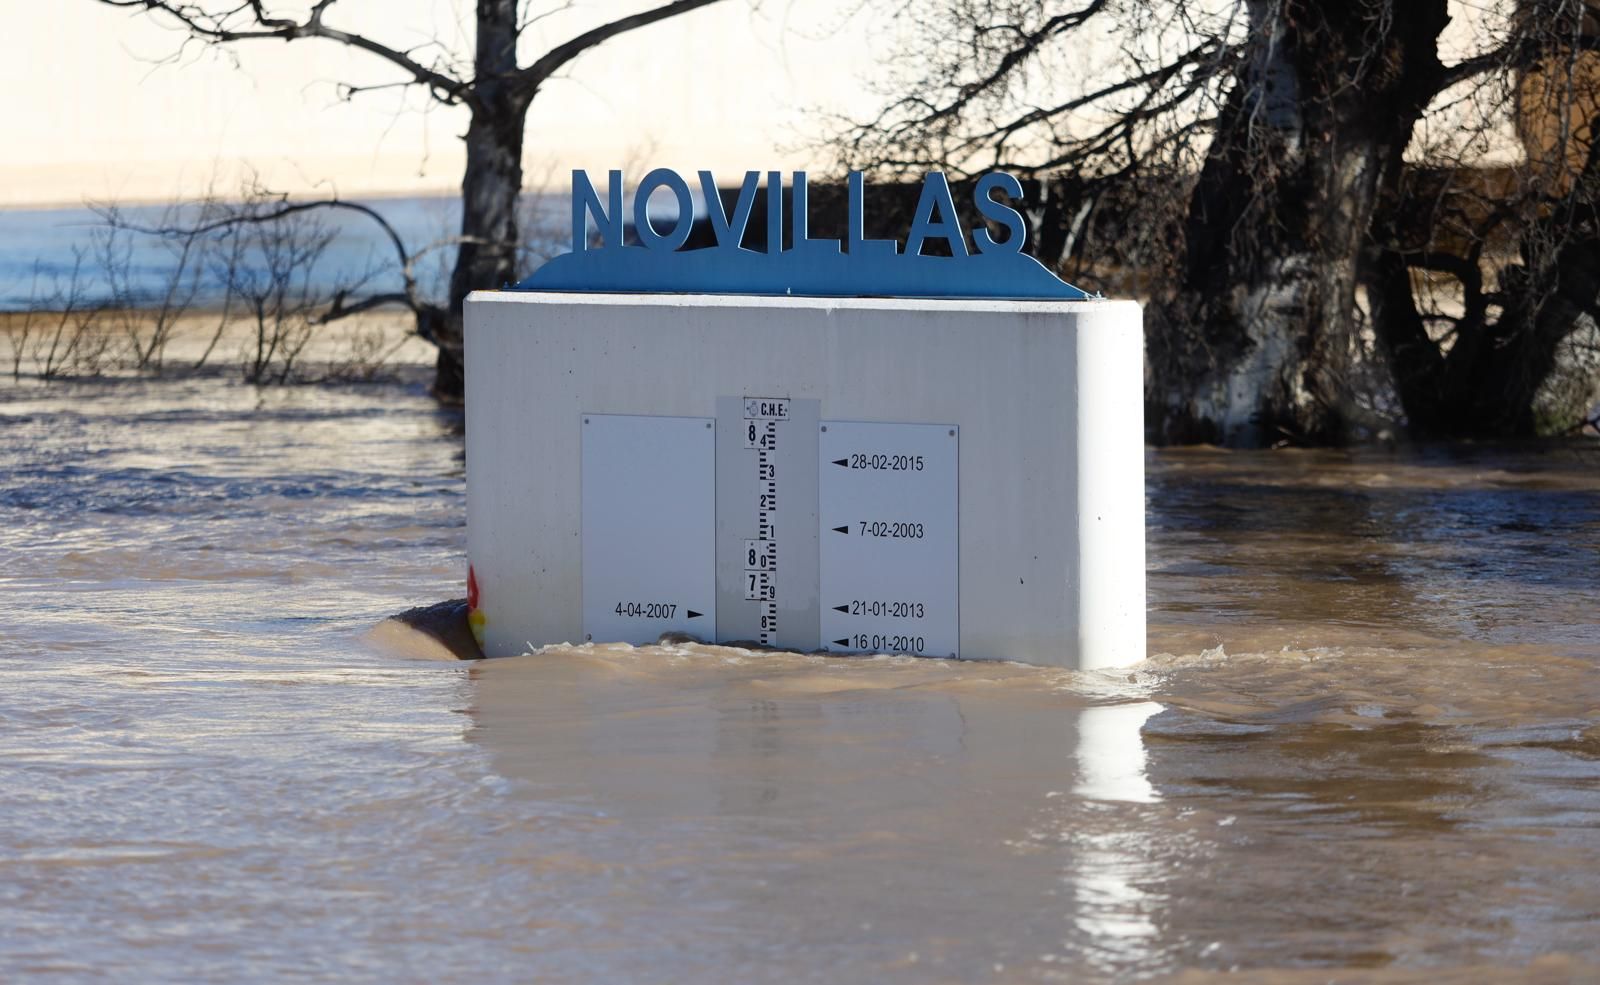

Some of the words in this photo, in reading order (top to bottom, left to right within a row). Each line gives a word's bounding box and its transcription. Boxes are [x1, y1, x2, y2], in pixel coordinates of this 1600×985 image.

[572, 168, 1026, 254] NOVILLAS
[761, 402, 786, 417] C.H.E.
[748, 424, 756, 442] 8
[760, 434, 767, 447] 4
[768, 464, 775, 478] 3
[851, 453, 924, 471] 28-02-2015
[760, 494, 767, 507] 2
[770, 525, 774, 538] 1
[860, 521, 924, 539] 7-02-2003
[748, 548, 756, 566] 8
[760, 554, 767, 568] 0
[748, 574, 756, 591] 7
[769, 586, 775, 599] 9
[615, 602, 677, 619] 4-04-2007
[852, 600, 924, 618] 21-01-2013
[761, 615, 767, 629] 8
